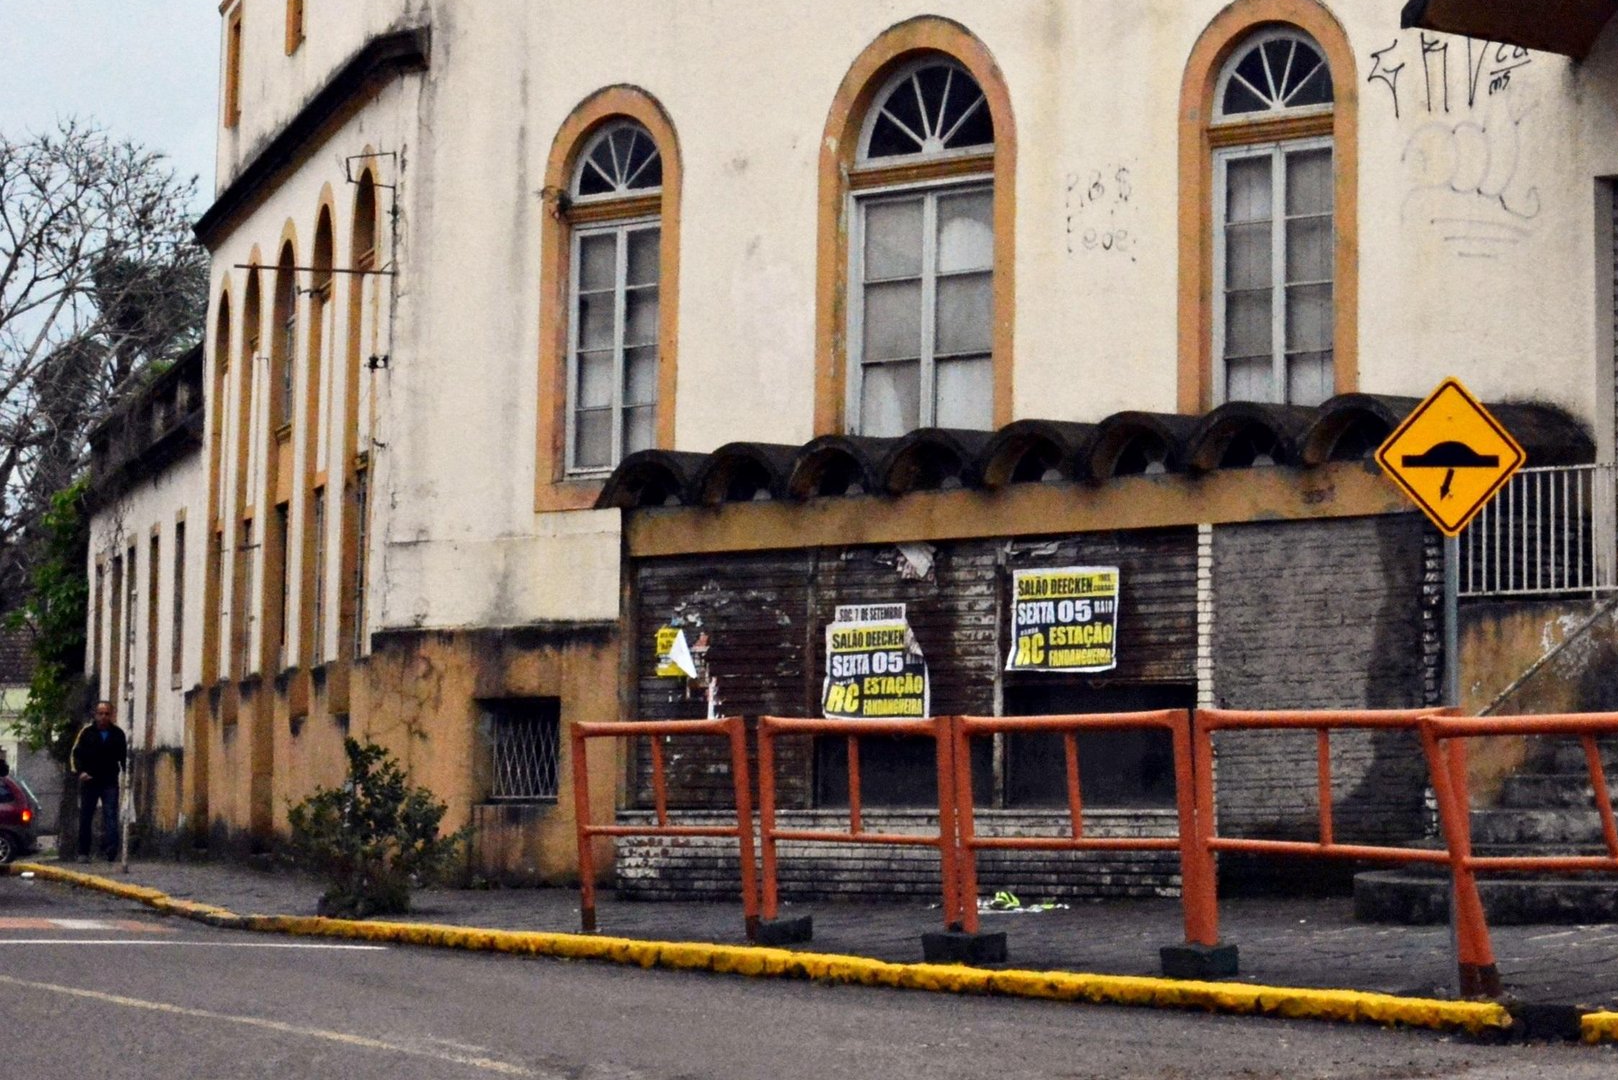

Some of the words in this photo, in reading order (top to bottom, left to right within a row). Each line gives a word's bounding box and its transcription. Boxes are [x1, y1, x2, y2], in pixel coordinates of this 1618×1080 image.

[1019, 576, 1048, 596] SALÃO
[1051, 577, 1093, 595] DEECKEN
[1018, 601, 1055, 625] SEXTA
[1057, 600, 1092, 623] 05
[832, 629, 863, 649] SALÃO
[866, 629, 905, 647] DEECKEN
[1049, 622, 1113, 647] ESTAÇÃO
[1015, 632, 1045, 666] RC
[832, 653, 870, 677] SEXTA
[872, 652, 904, 673] 05
[826, 683, 859, 712] RC
[863, 673, 923, 697] ESTAÇÃO
